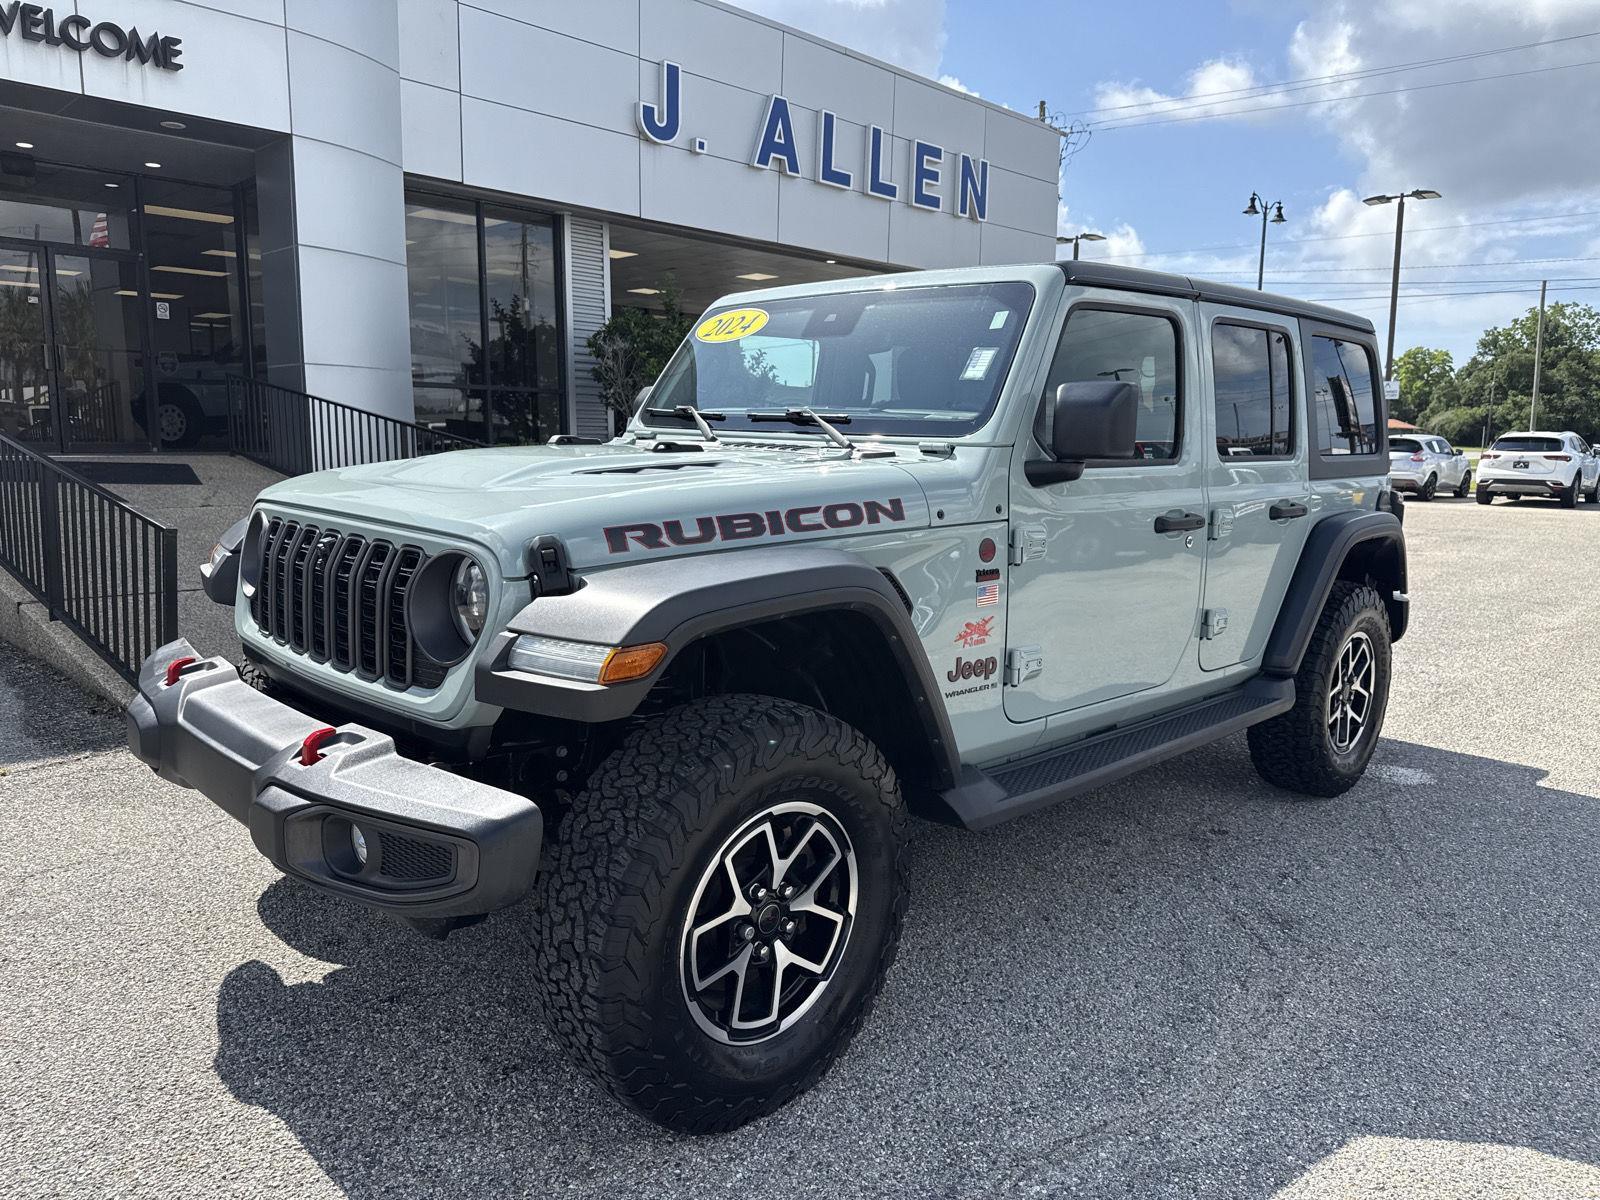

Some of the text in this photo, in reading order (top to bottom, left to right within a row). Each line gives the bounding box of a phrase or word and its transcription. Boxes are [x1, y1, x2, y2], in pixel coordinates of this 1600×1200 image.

[635, 60, 990, 223] J. ALLEN
[702, 313, 762, 338] 2024
[603, 498, 906, 554] RUBICON
[947, 656, 998, 682] Jeep
[945, 684, 990, 698] WRANGLER
